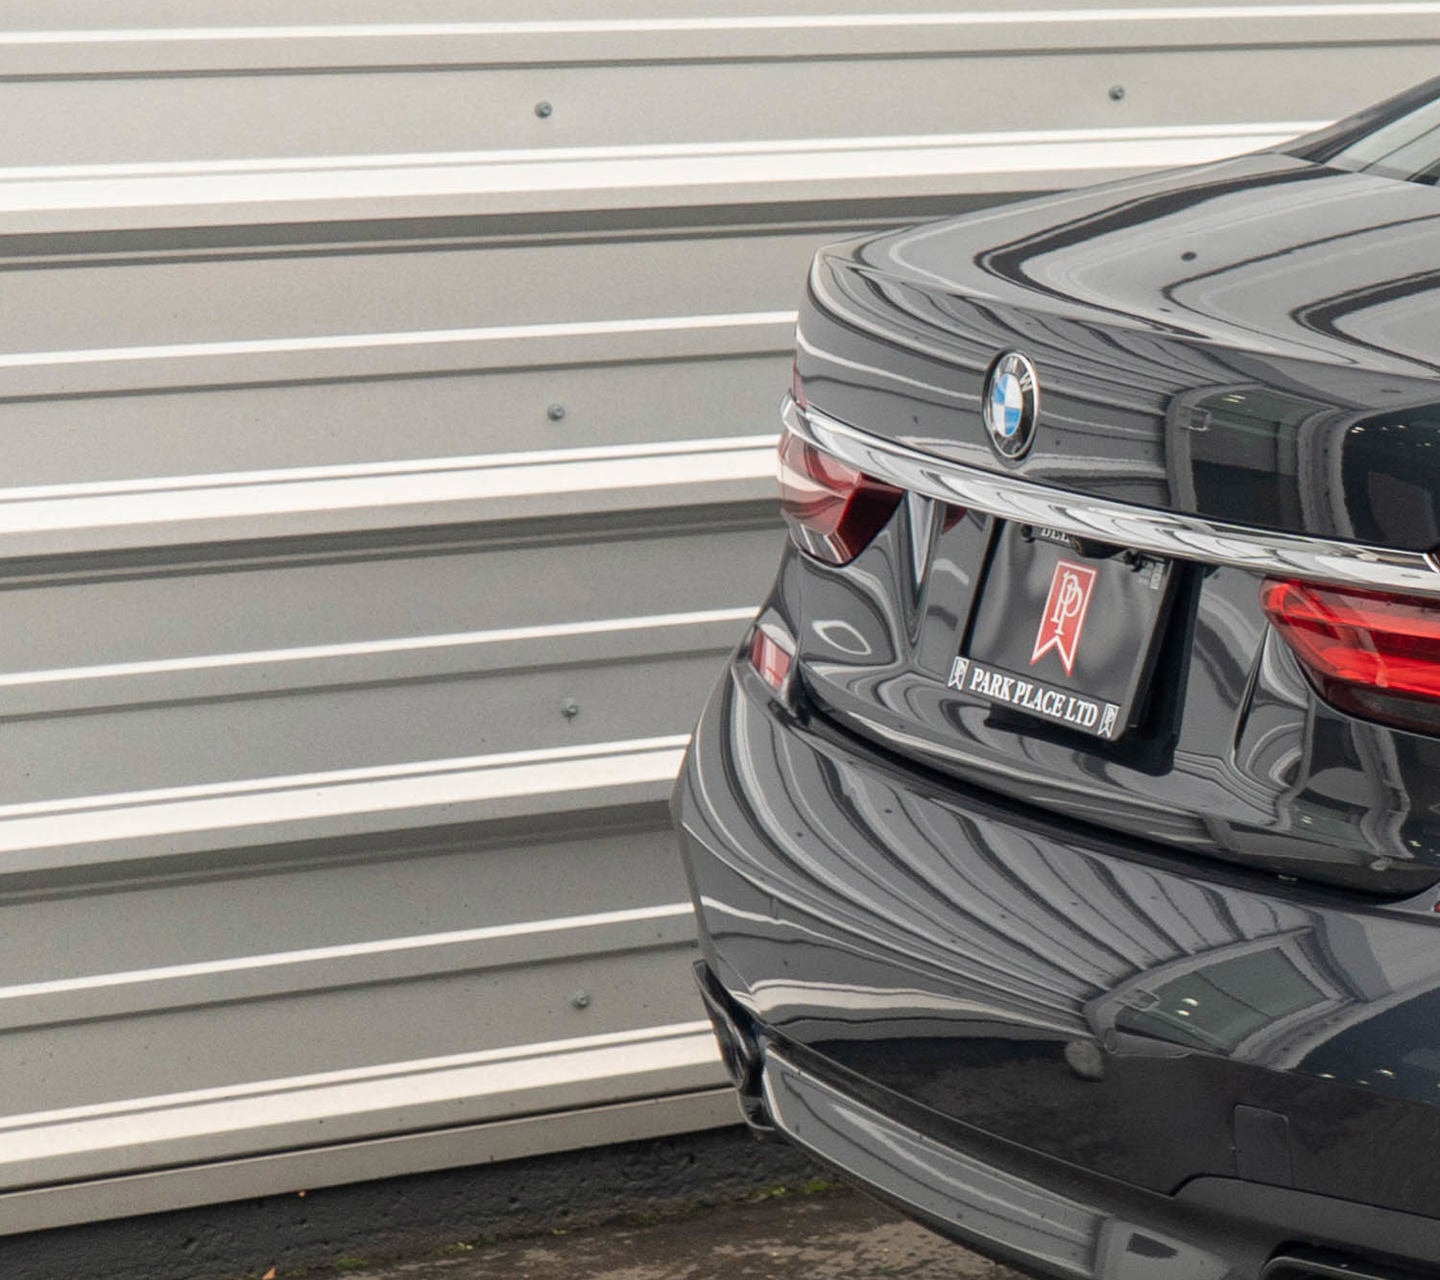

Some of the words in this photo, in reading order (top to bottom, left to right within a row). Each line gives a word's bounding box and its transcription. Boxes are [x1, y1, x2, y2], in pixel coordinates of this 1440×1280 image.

[969, 667, 1015, 702] PARK
[1011, 681, 1066, 720] PLACE
[1062, 699, 1099, 728] LTD
